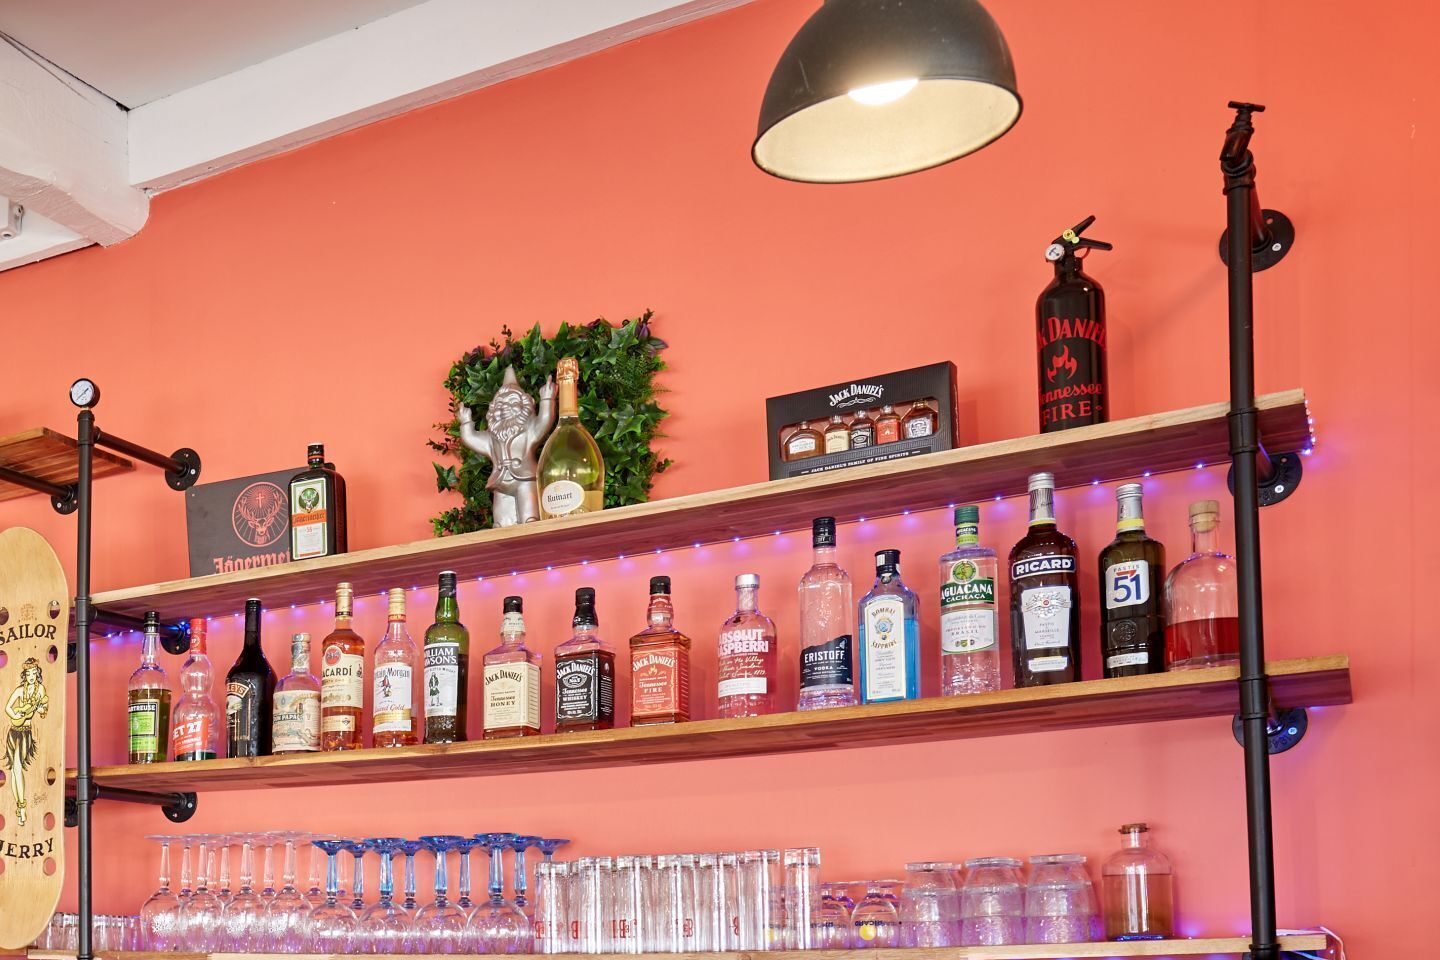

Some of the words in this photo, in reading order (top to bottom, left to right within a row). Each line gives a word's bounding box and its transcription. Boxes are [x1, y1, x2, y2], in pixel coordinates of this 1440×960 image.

[828, 389, 851, 407] JACK
[850, 384, 885, 399] DANIEL'S
[1043, 401, 1092, 425] FIRE
[547, 492, 573, 502] Ruinart
[1016, 559, 1072, 575] RICARD
[1113, 564, 1140, 573] PASTIS
[1113, 573, 1142, 602] 51
[946, 593, 986, 603] CACHAÇA
[632, 657, 649, 672] JACK
[649, 654, 675, 668] DANIEL'S
[804, 650, 845, 663] ERISTOFF
[387, 667, 410, 678] Morgan
[485, 672, 500, 686] JACK
[499, 669, 522, 683] DANIEL'S
[556, 665, 571, 679] JACK
[570, 662, 596, 676] DANIEL'S
[490, 700, 516, 708] HONEY
